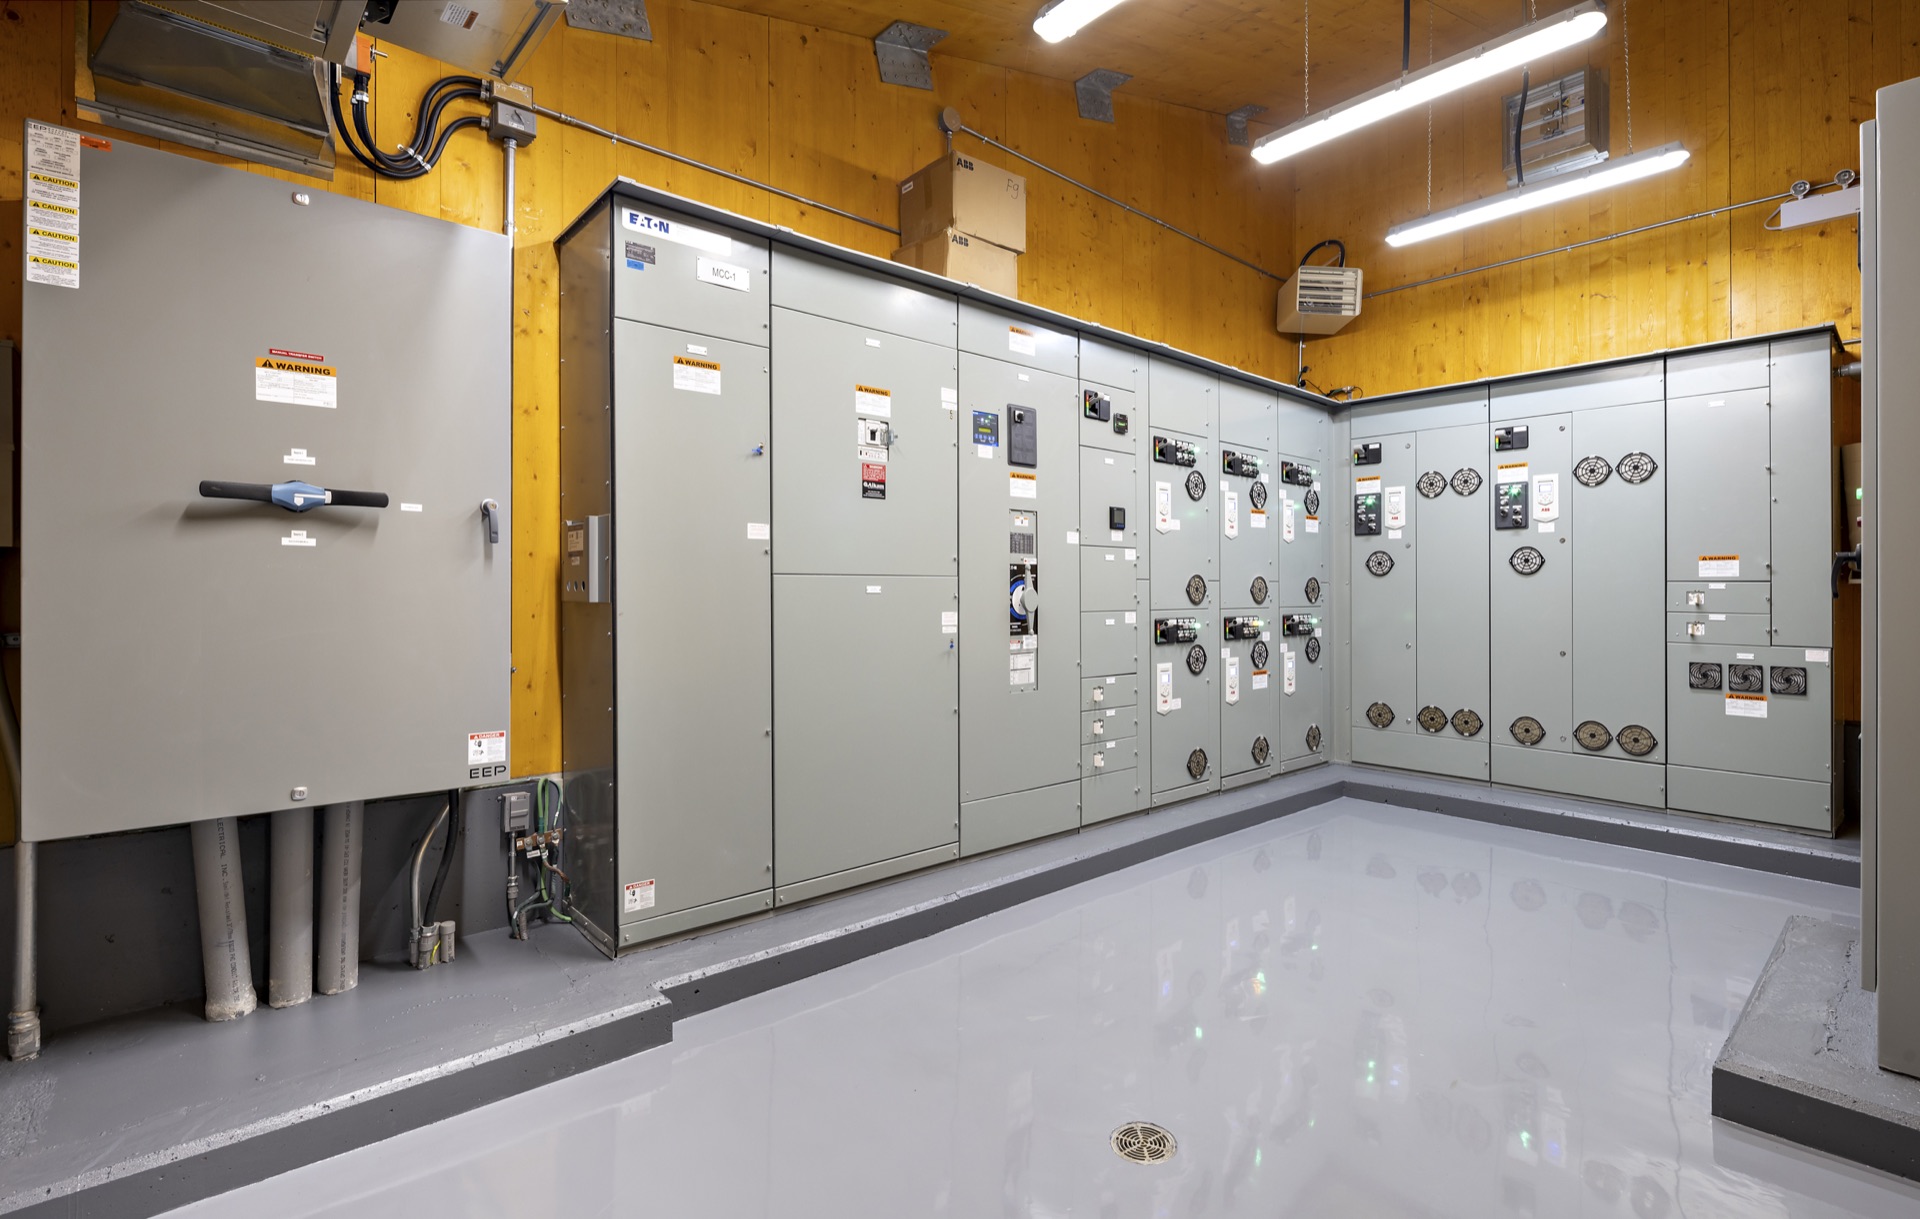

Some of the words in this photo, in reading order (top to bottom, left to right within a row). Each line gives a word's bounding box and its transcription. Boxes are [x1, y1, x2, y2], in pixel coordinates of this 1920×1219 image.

[956, 157, 974, 171] ABB
[42, 175, 75, 188] CAUTION
[42, 203, 75, 215] CAUTION
[629, 212, 670, 234] EATON
[42, 230, 75, 242] CAUTION
[952, 234, 969, 248] ABB
[42, 257, 75, 269] CAUTION
[712, 267, 736, 282] MCC-1
[276, 362, 331, 376] WARNING
[685, 359, 718, 371] WARNING
[864, 387, 889, 397] WARNING
[469, 765, 507, 779] EEP
[216, 818, 226, 859] LECTRICAL
[633, 881, 651, 889] DANGER
